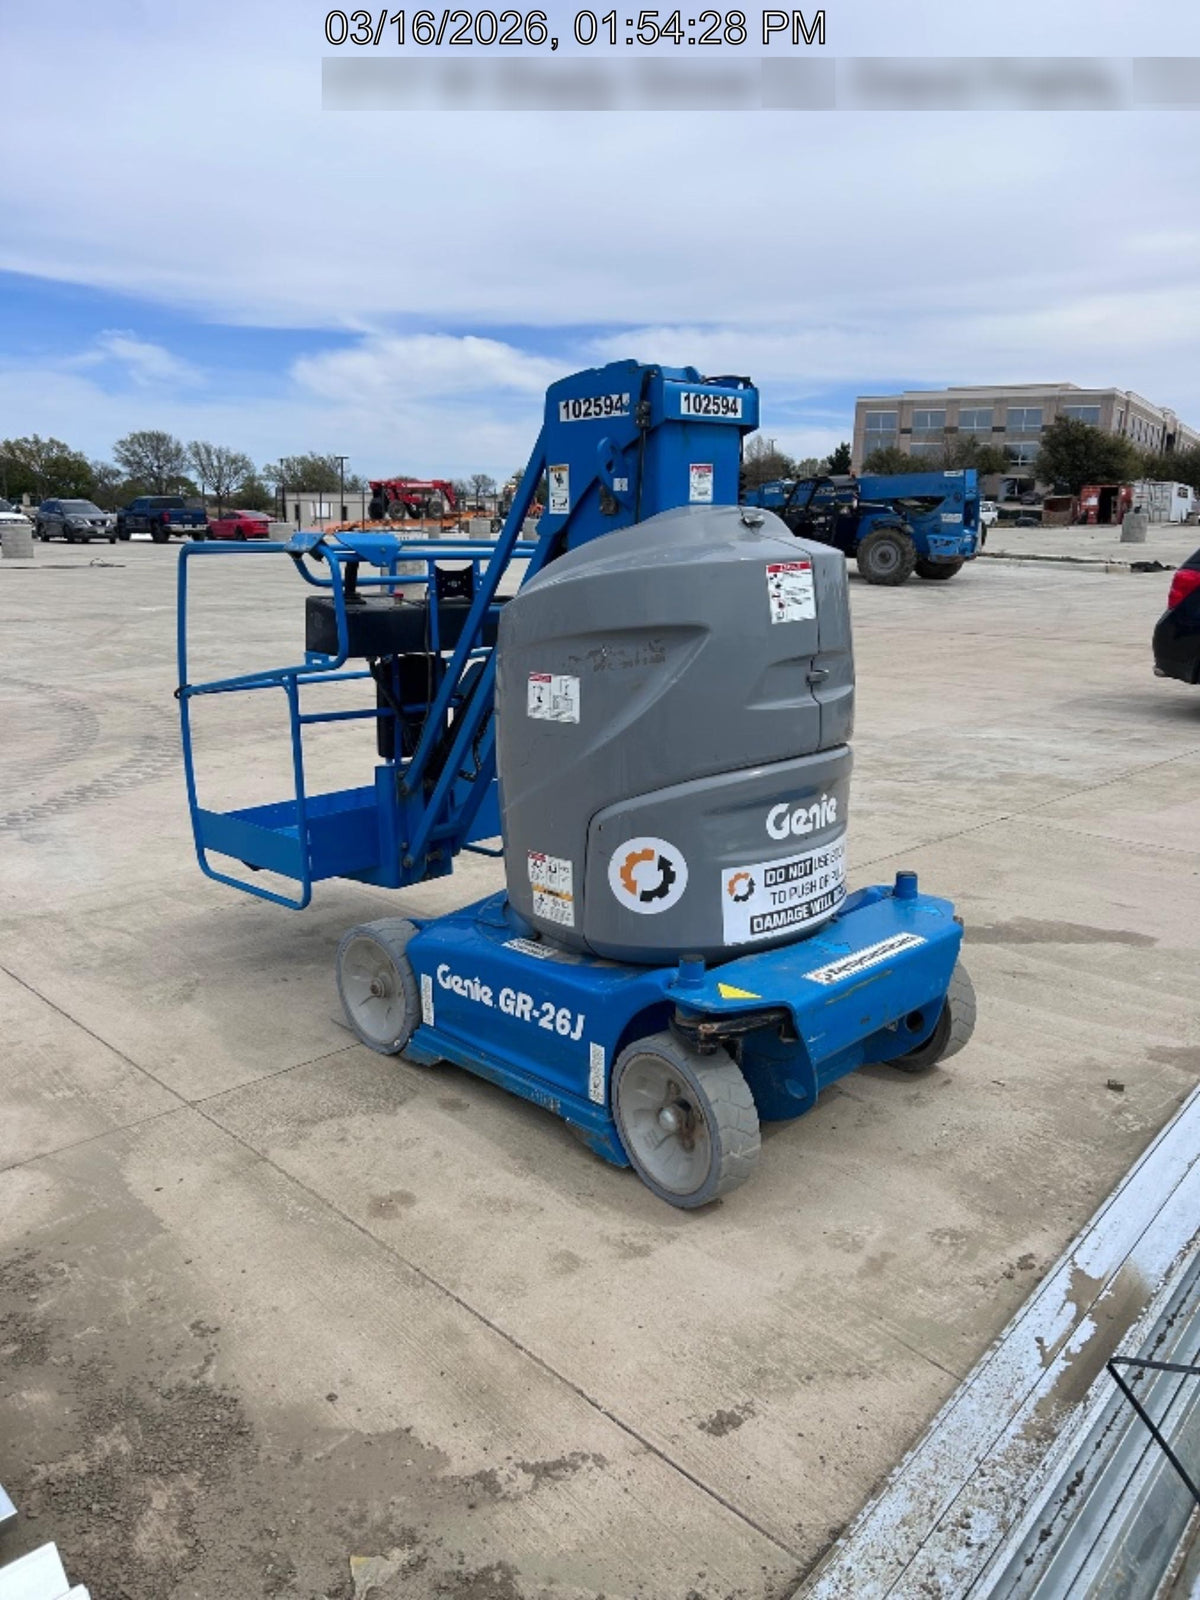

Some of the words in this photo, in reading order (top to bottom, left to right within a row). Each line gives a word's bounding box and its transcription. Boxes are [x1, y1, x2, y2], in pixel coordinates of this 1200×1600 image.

[562, 394, 624, 420] 102594
[683, 391, 739, 417] 102594
[766, 793, 837, 840] Genie
[766, 869, 785, 885] DO
[788, 861, 812, 882] NOT
[770, 889, 786, 906] TO
[789, 880, 817, 900] PUSH
[752, 905, 809, 932] DAMAGE
[810, 896, 833, 915] WILL
[436, 963, 493, 1007] Genie
[499, 987, 586, 1041] GR-26J
